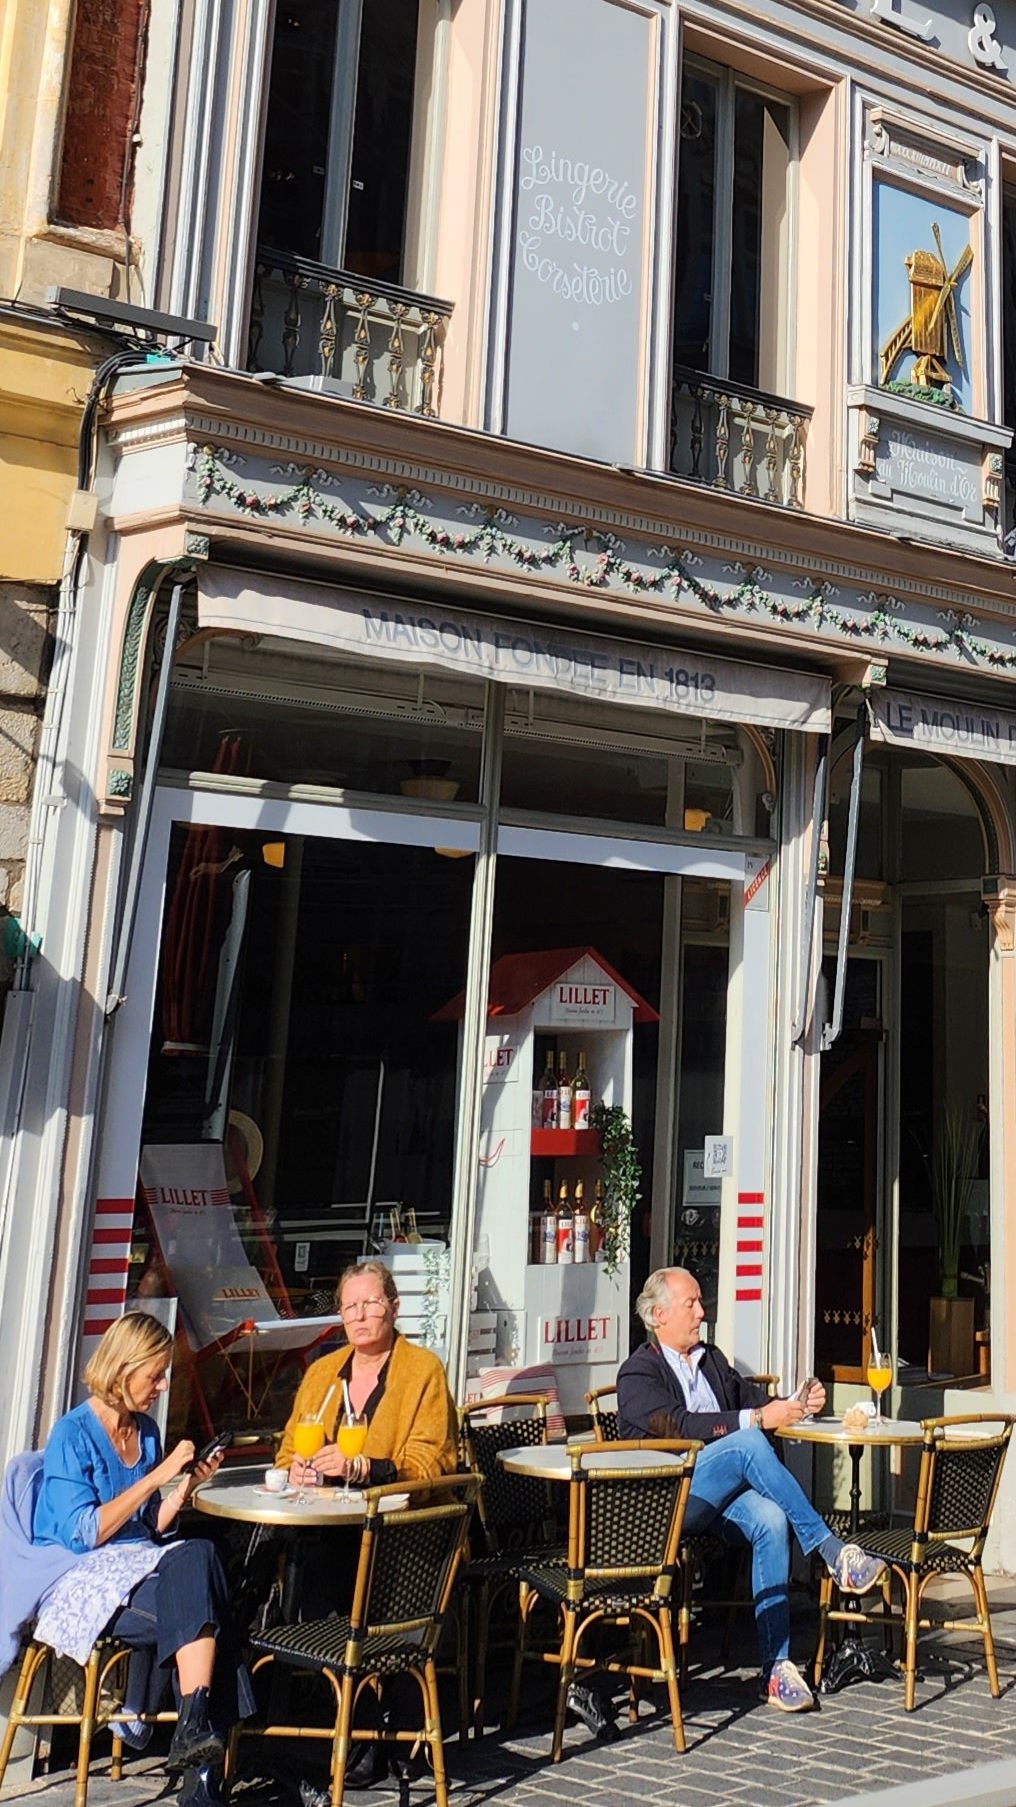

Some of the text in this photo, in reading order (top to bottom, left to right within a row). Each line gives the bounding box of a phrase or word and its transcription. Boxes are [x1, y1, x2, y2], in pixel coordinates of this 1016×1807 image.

[967, 2, 1009, 69] &
[521, 145, 637, 219] Lingerie
[528, 193, 631, 257] Bistrot
[889, 429, 959, 473] Maison
[878, 460, 893, 481] du
[897, 459, 949, 493] Moulin
[362, 608, 484, 661] MAISON
[618, 657, 656, 694] EN
[664, 667, 716, 704] 1813
[885, 701, 914, 733] LE
[919, 708, 1000, 750] MOULIN
[559, 986, 610, 1006] LILLET
[481, 1048, 514, 1068] LET
[160, 1187, 208, 1207] LILLET
[222, 1287, 261, 1299] LILLET
[543, 1317, 611, 1345] LILLET
